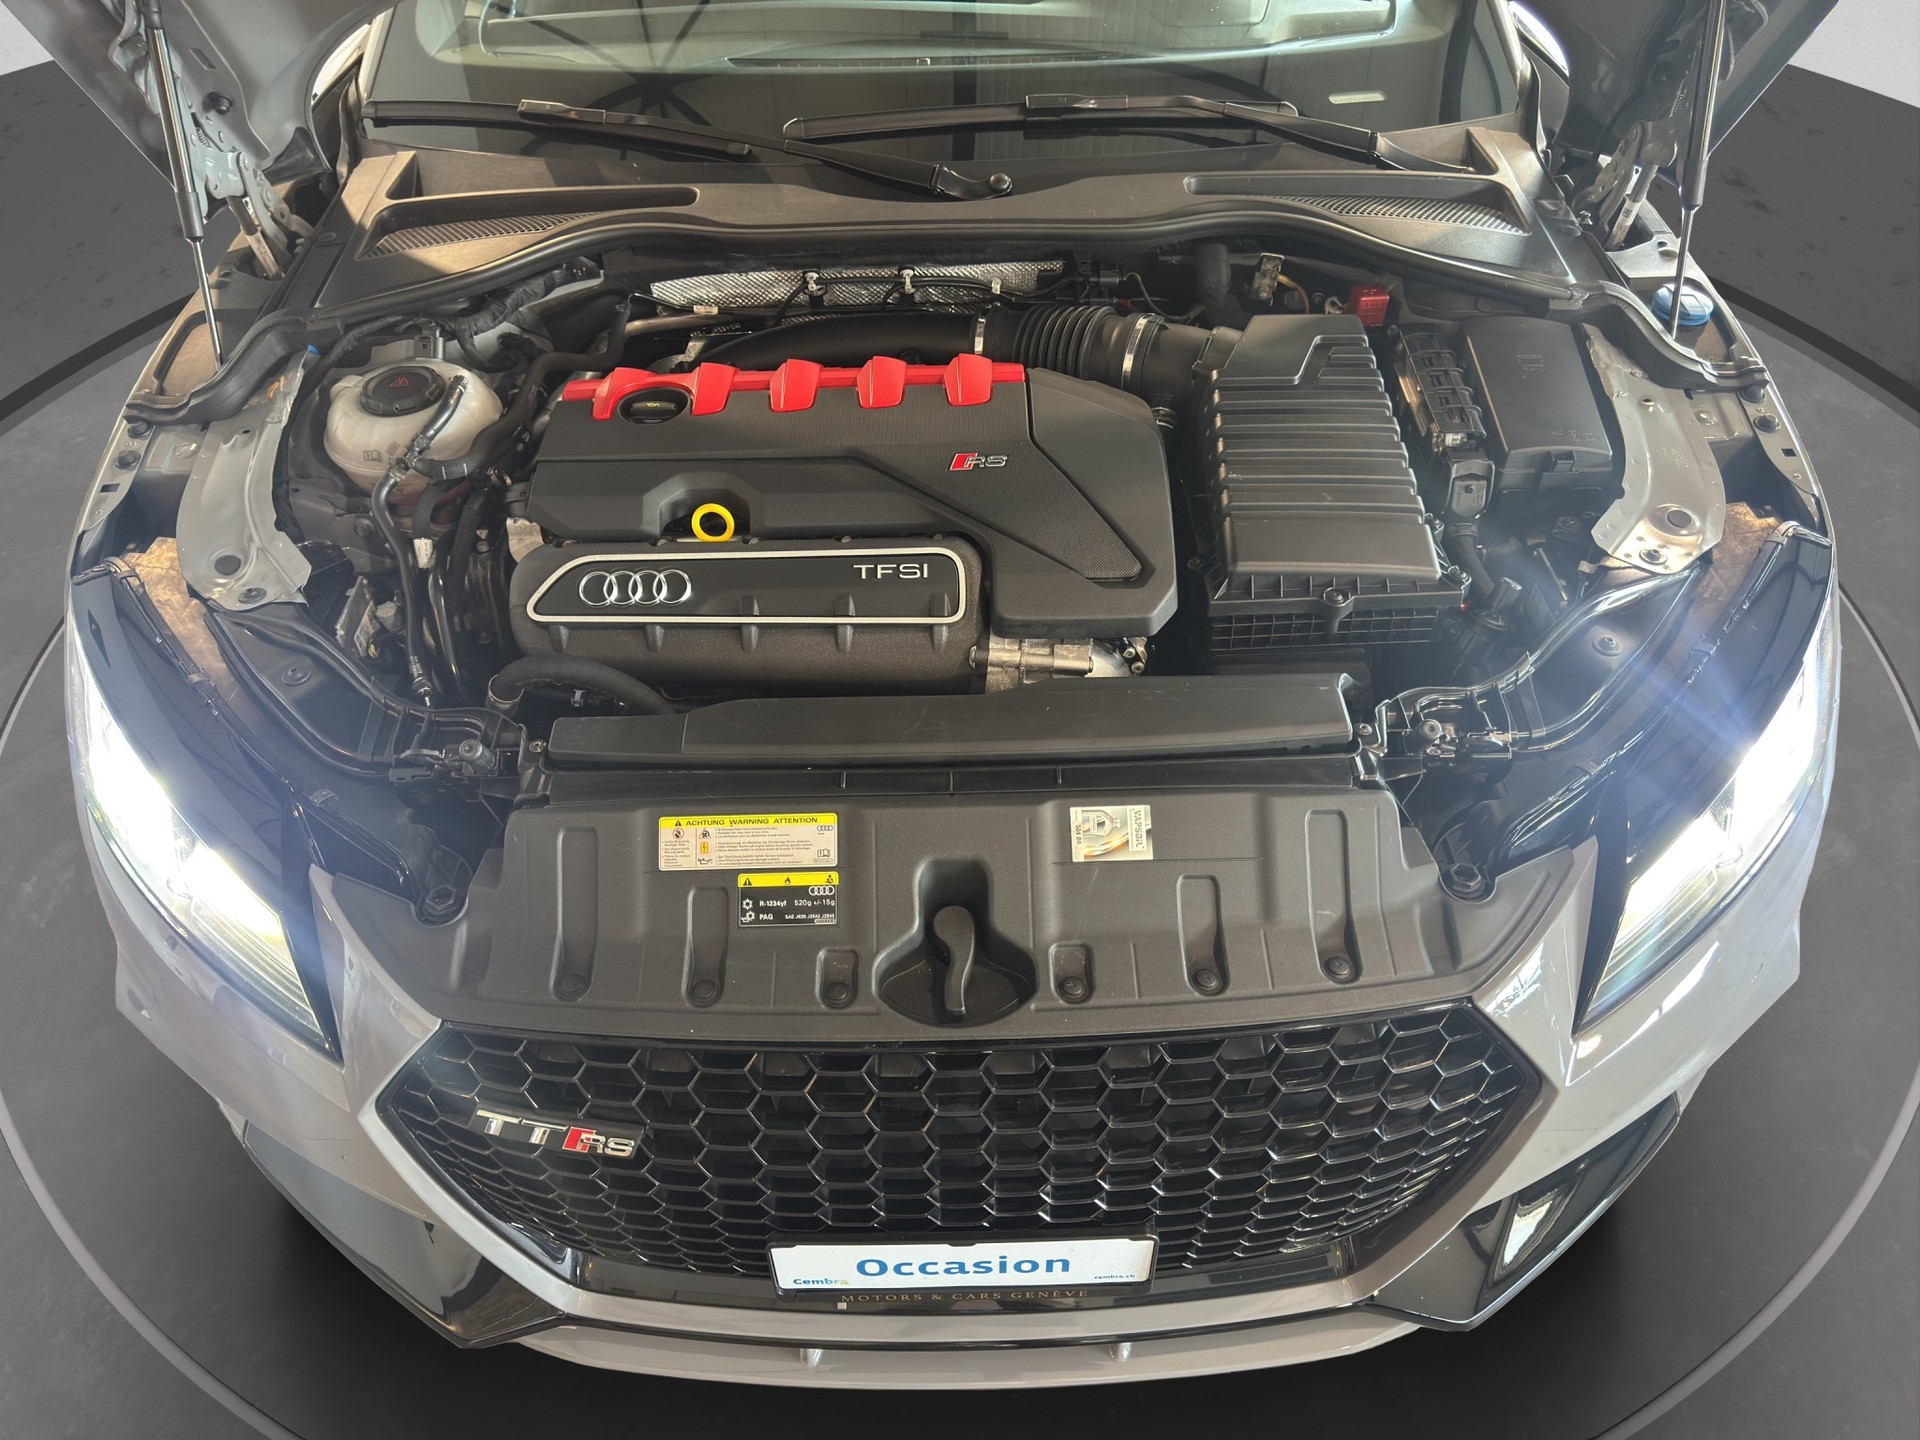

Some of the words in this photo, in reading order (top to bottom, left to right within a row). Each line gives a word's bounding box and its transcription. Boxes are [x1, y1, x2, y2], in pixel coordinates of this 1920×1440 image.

[950, 453, 1008, 471] RS
[853, 563, 929, 580] TFSI
[759, 900, 787, 908] R-1234yf
[856, 1255, 1070, 1277] Occasion
[793, 1278, 849, 1286] Cembra
[841, 1294, 923, 1302] MOTORS
[952, 1292, 1002, 1301] CARS
